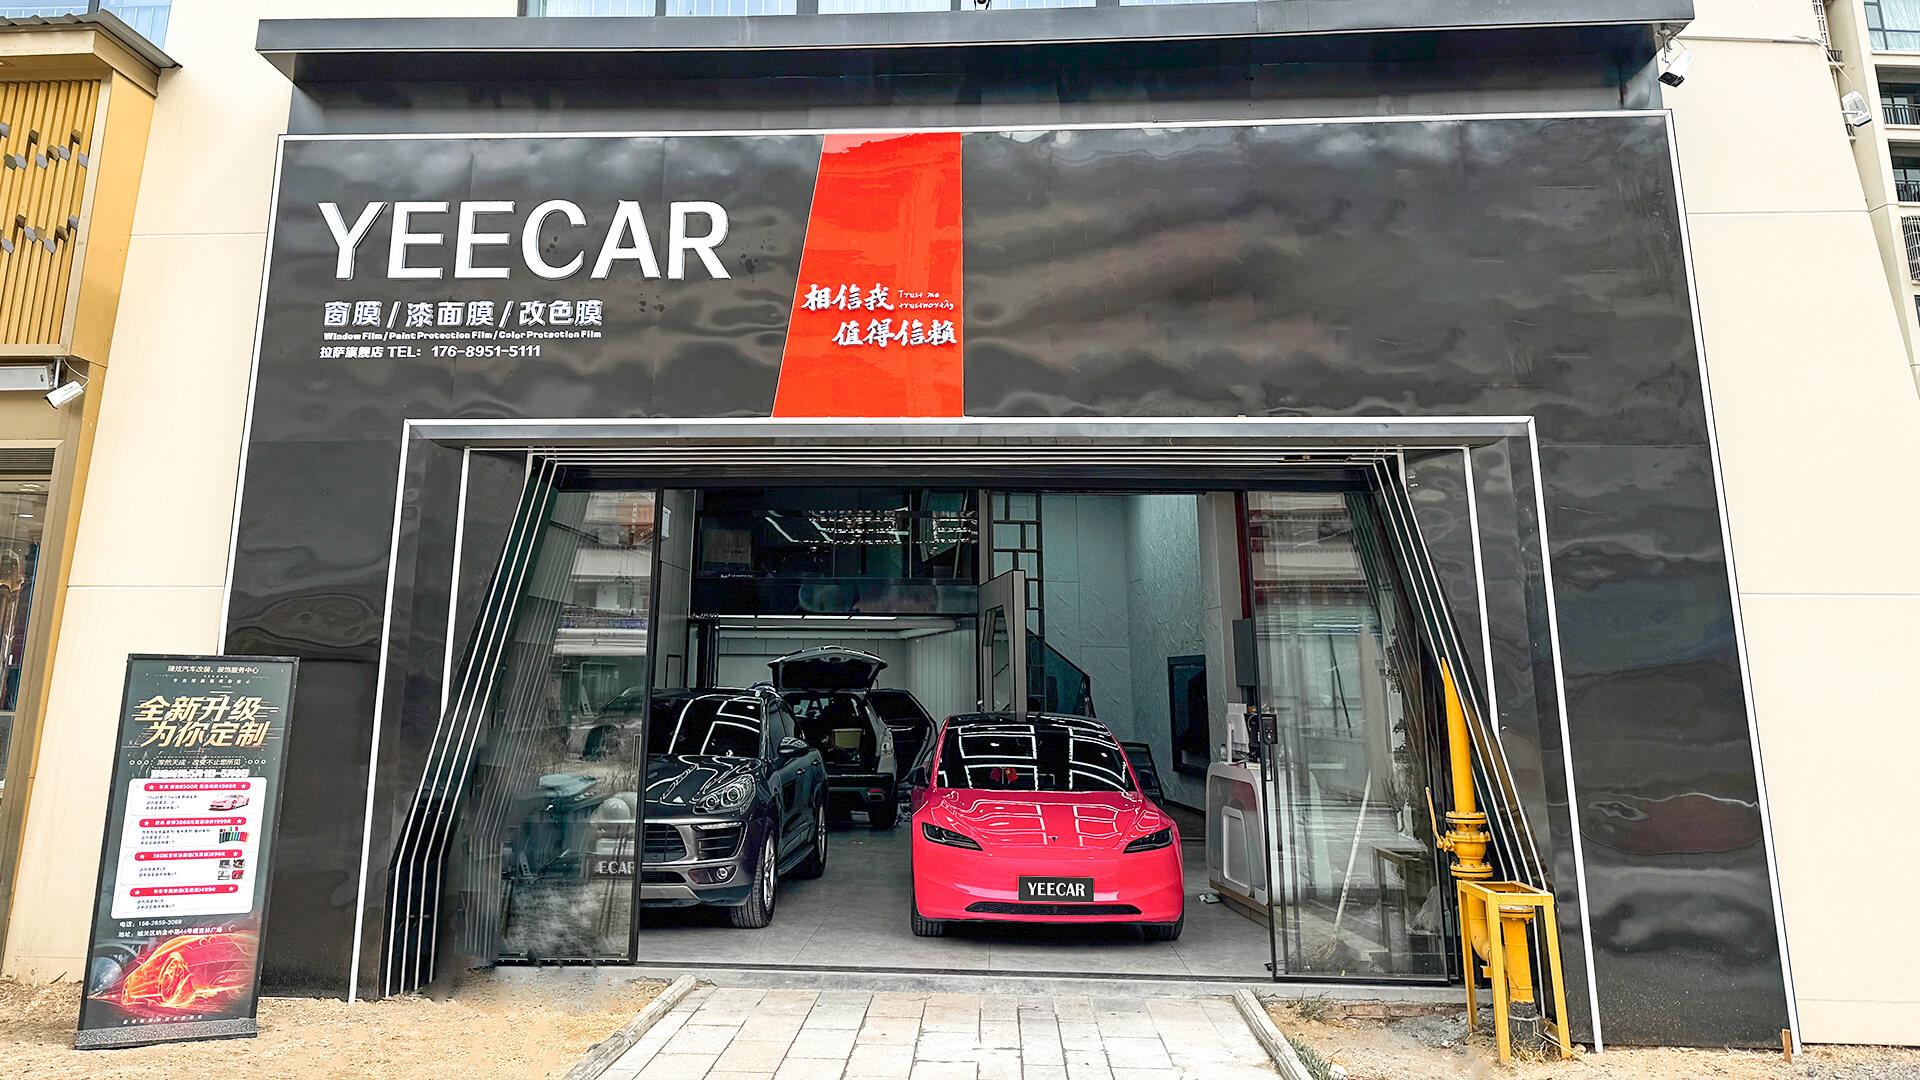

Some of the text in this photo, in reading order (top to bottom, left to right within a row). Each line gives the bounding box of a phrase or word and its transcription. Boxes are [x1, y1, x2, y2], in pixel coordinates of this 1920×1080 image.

[317, 199, 731, 280] YEECAR
[801, 283, 895, 311] 相信我
[898, 290, 923, 298] Trust
[323, 332, 361, 340] Window
[417, 332, 470, 340] Protection
[527, 330, 580, 339] Protection
[581, 330, 602, 338] Film
[320, 346, 384, 358] 拉萨旗舰店
[431, 345, 540, 358] 176-8951-5111
[134, 696, 263, 722] 全新升级
[140, 721, 271, 748] 为你定制
[1027, 882, 1086, 897] YEECAR
